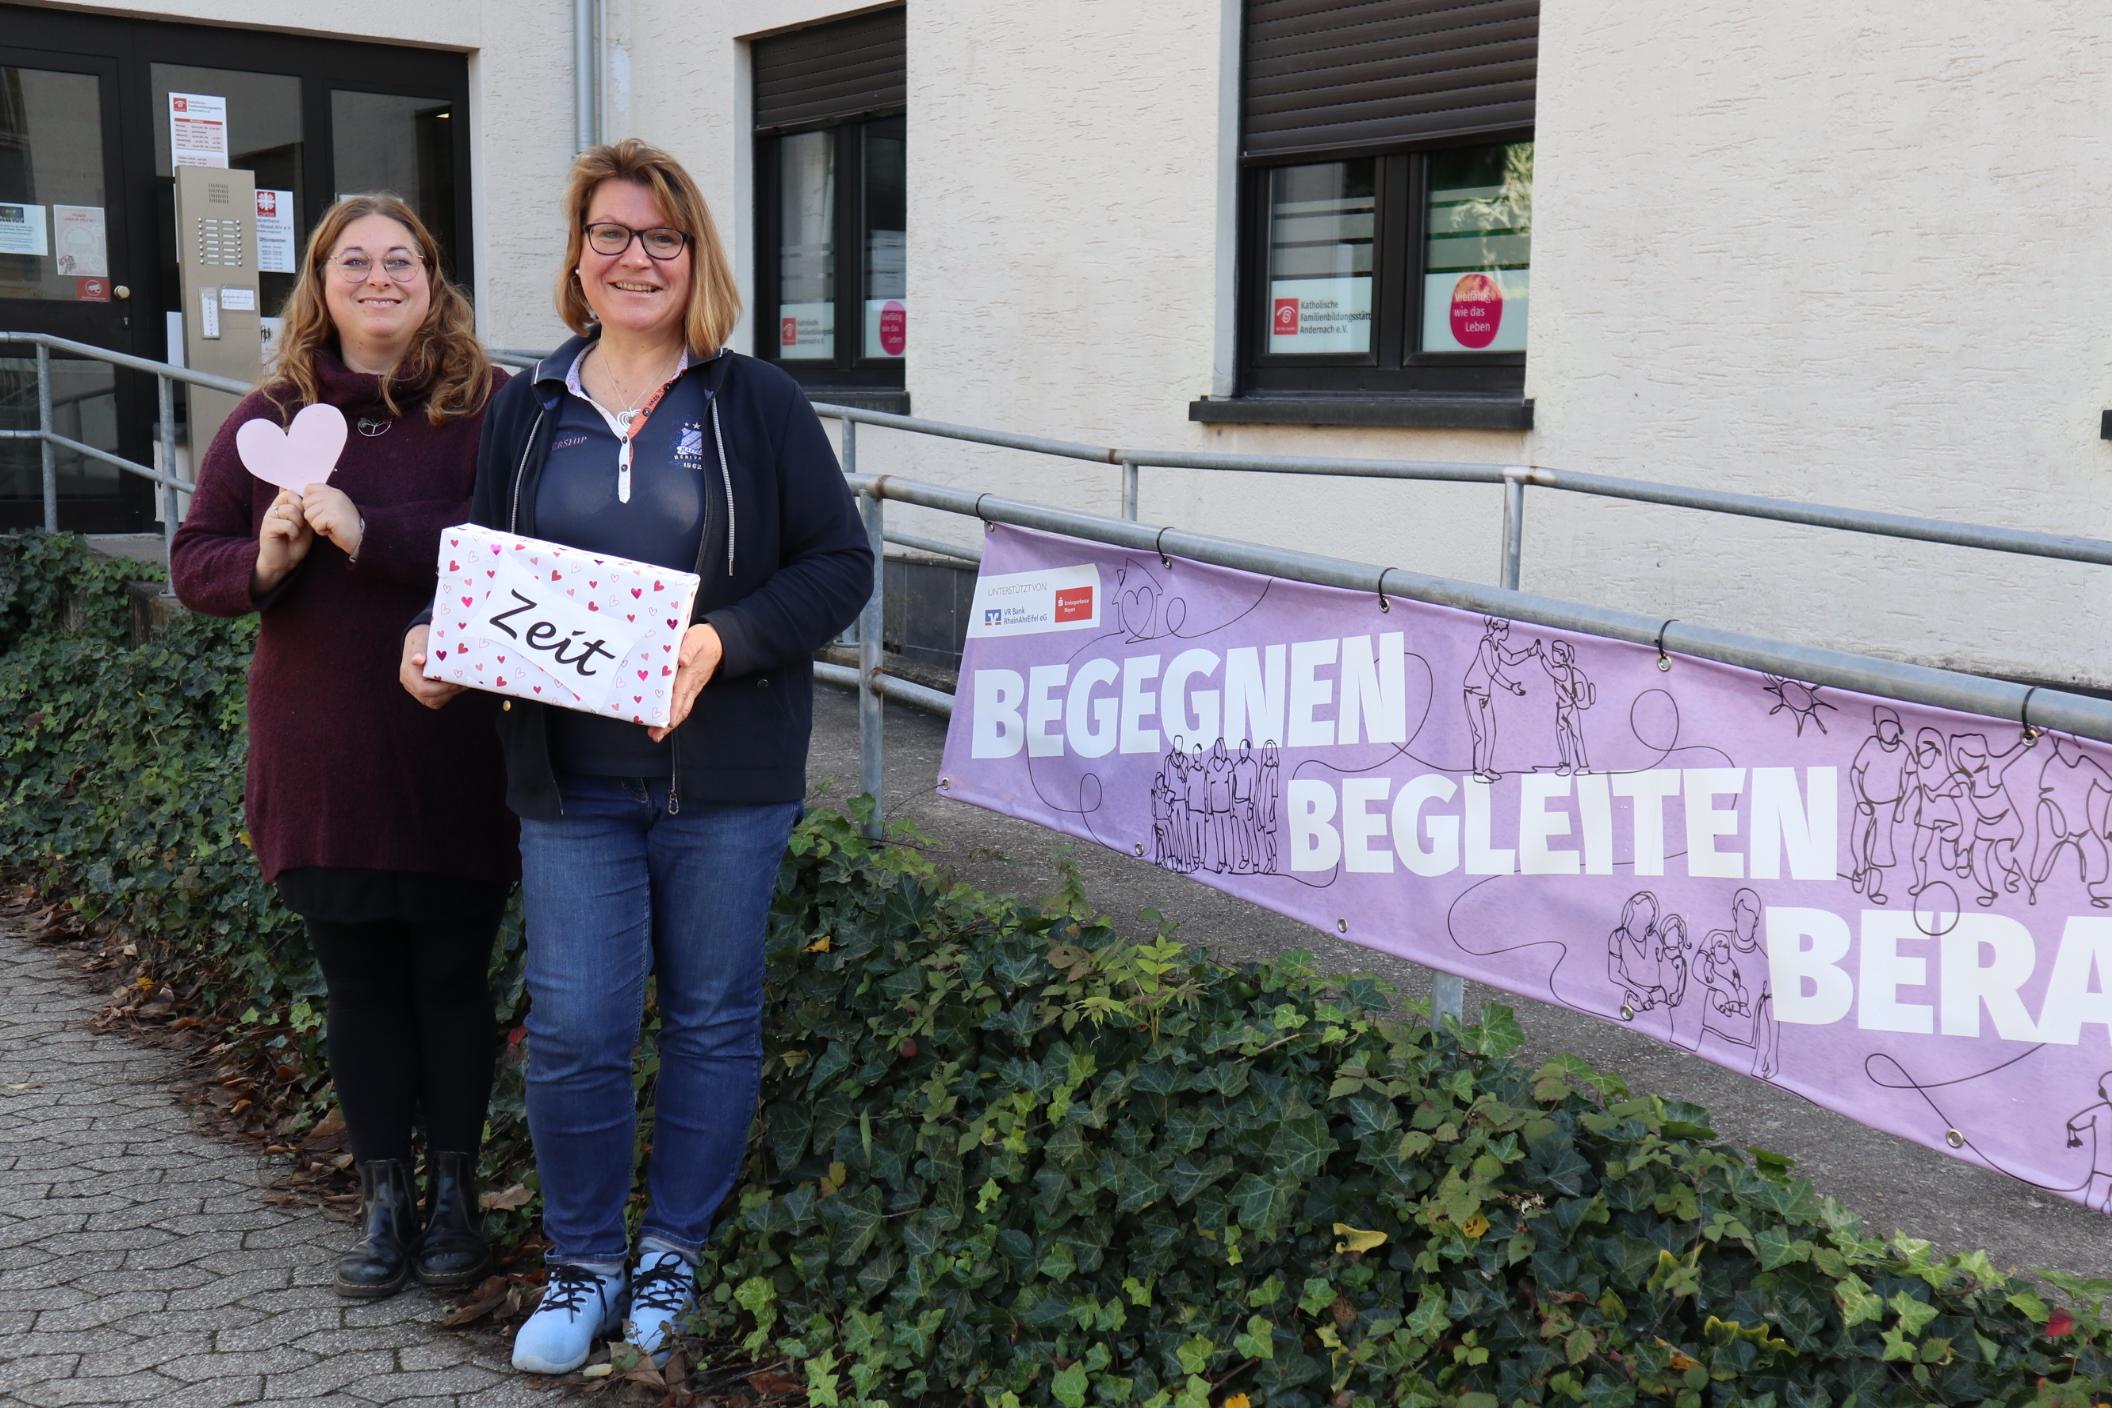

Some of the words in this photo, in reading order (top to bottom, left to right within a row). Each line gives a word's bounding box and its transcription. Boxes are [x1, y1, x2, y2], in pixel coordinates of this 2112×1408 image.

[1300, 300, 1339, 309] Katholische
[1300, 310, 1373, 322] Familienbildungsstätt
[1454, 305, 1469, 317] wie
[1470, 305, 1485, 317] das
[1300, 325, 1335, 334] Andernach
[1465, 321, 1491, 332] Leben
[1031, 582, 1048, 593] VON
[1012, 606, 1024, 615] Bank
[489, 588, 616, 676] Zeit
[971, 632, 1406, 759] BEGEGNEN
[1287, 766, 1839, 881] BEGLEITEN
